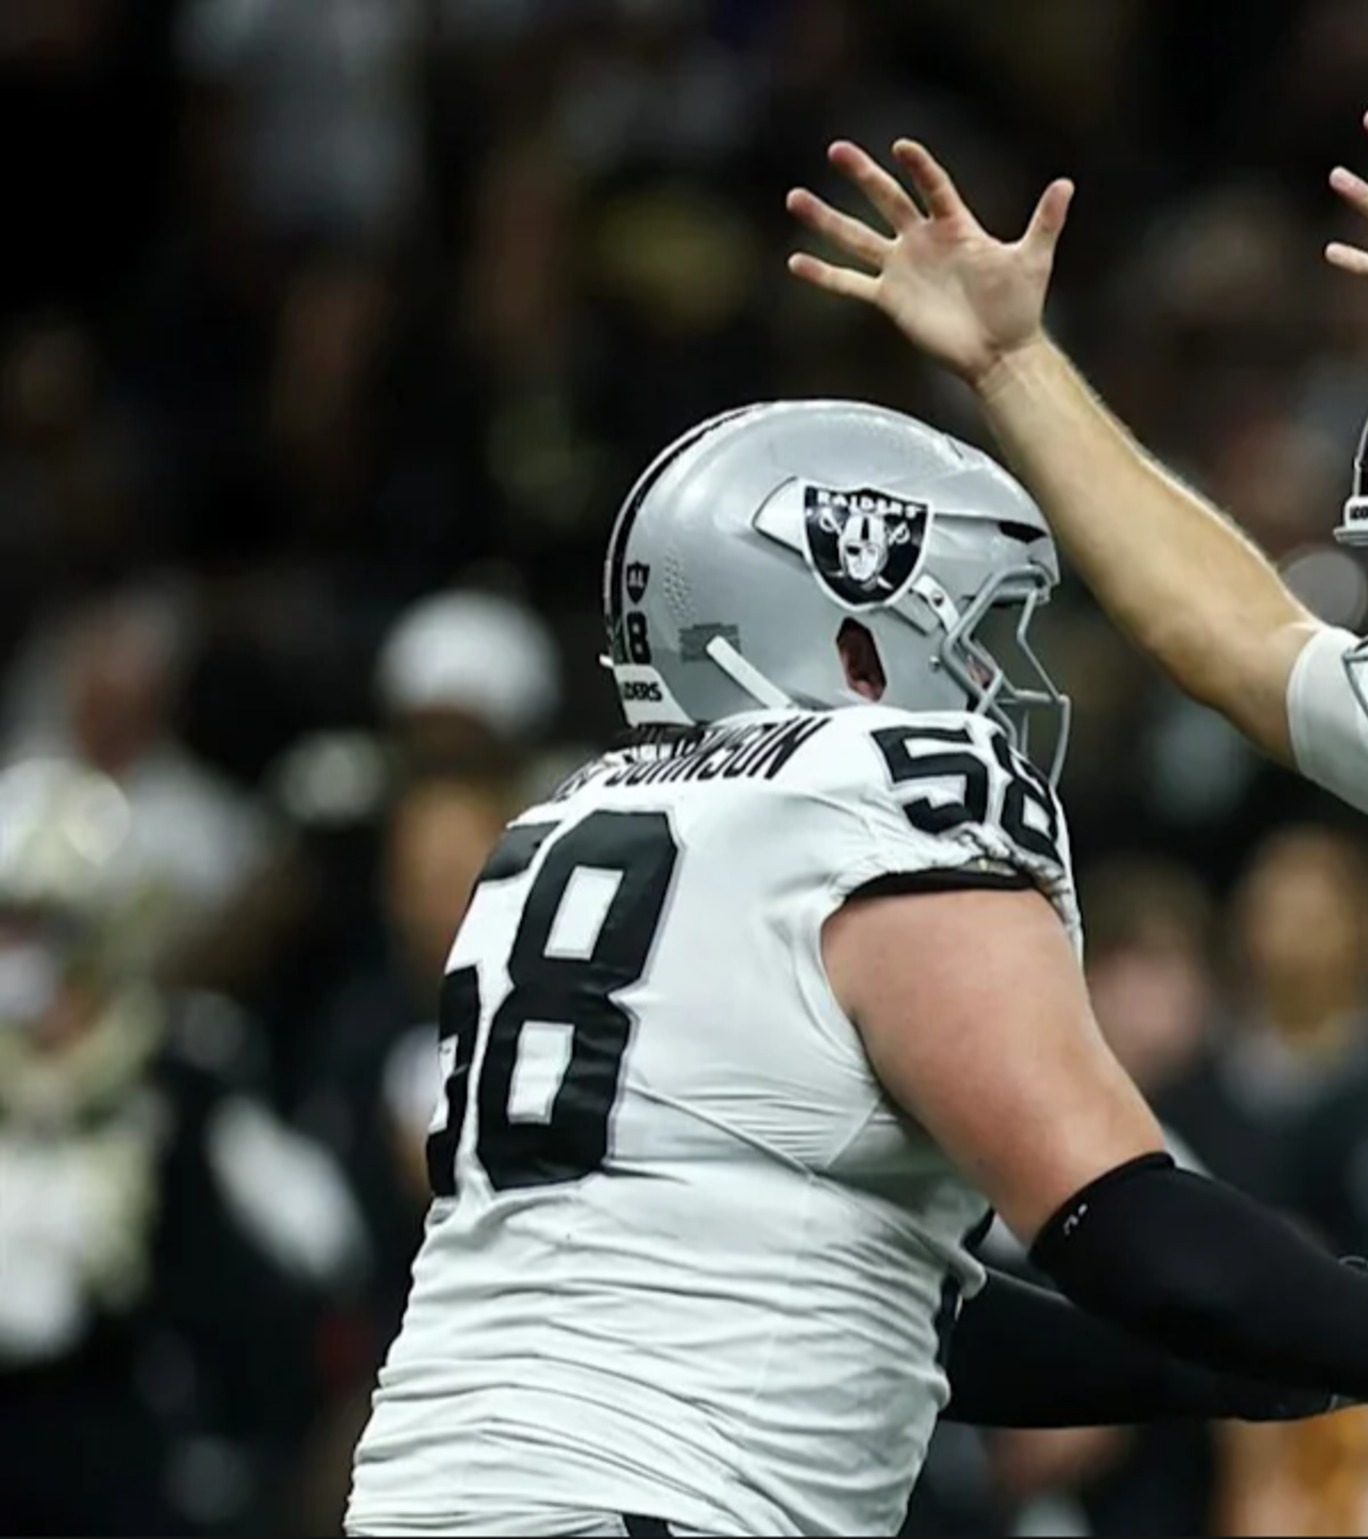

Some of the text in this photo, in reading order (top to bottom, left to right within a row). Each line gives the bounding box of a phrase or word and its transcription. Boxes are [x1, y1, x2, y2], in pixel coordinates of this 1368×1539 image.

[817, 491, 924, 519] RAIDERS
[870, 725, 1065, 868] 58
[426, 810, 678, 1197] 58
